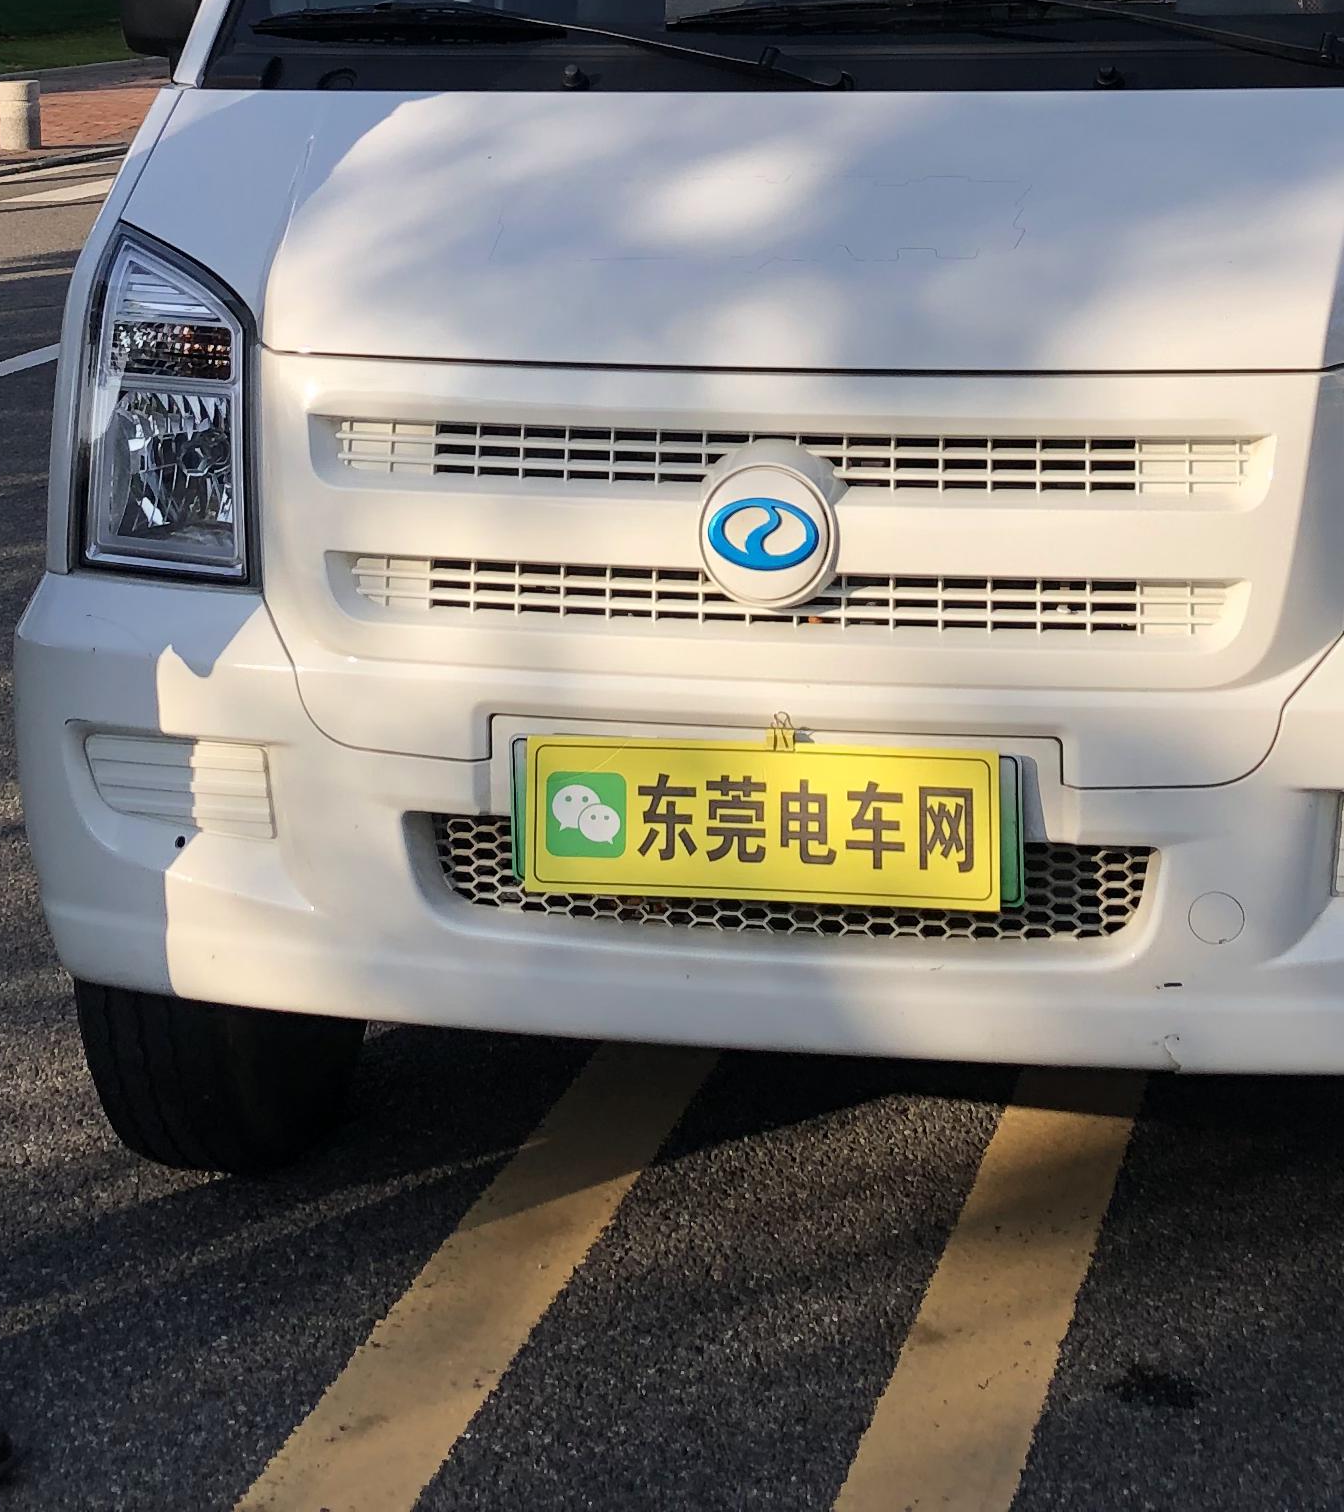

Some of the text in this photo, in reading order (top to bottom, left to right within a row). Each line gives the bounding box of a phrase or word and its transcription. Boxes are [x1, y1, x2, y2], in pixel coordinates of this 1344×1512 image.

[637, 771, 976, 874] 东莞电车网
